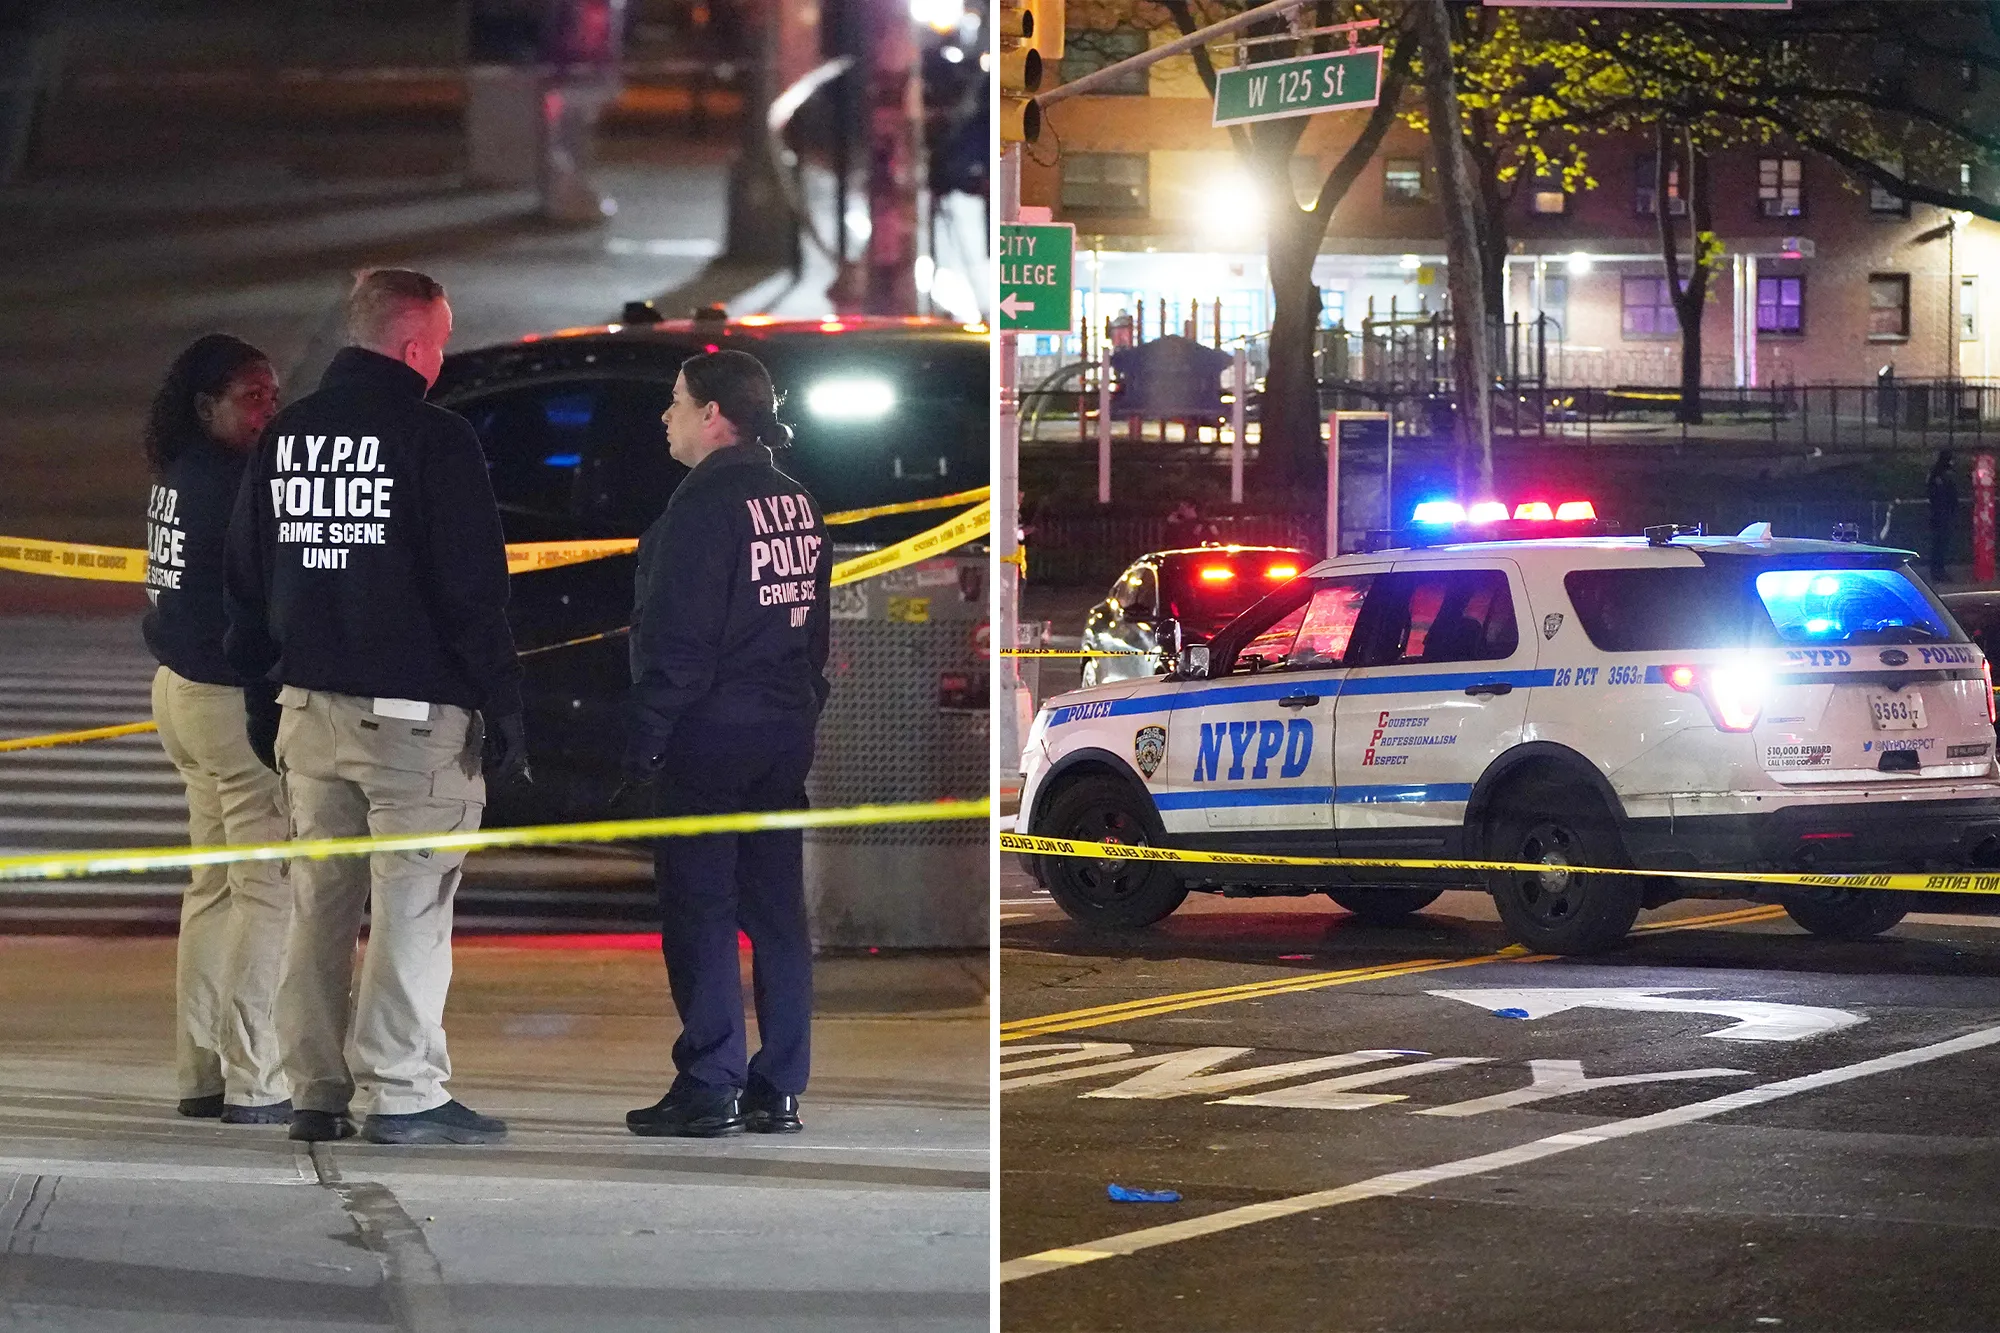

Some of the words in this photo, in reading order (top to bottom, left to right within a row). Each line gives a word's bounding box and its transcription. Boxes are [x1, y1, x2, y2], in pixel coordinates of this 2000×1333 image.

[1248, 76, 1268, 108] W
[1278, 69, 1312, 104] 125
[1322, 64, 1345, 98] St
[1000, 264, 1057, 285] LLEGE
[276, 435, 386, 473] N.Y.P.D.
[147, 484, 180, 526] Y.P.D.
[270, 477, 394, 518] POLICE
[278, 522, 324, 543] RIME
[329, 522, 386, 544] SCENE
[148, 522, 186, 568] LICE
[303, 547, 350, 569] UNIT
[751, 535, 822, 581] POLIC
[760, 582, 800, 606] CRIME
[801, 580, 816, 601] SCE
[1917, 647, 1975, 664] POLICE
[1555, 668, 1572, 687] 26
[1574, 667, 1599, 686] PCT
[1067, 701, 1112, 722] POLICE
[1874, 702, 1908, 720] 3563
[1193, 718, 1314, 782] NYPD
[1767, 746, 1799, 756] $10,000
[1800, 745, 1832, 755] REWARD
[1875, 738, 1936, 751] @NYPD26PCT
[1000, 835, 1034, 849] ENTER
[1036, 839, 1057, 851] NOT
[1057, 841, 1075, 853] DO
[1101, 846, 1139, 857] ENTER
[1141, 849, 1163, 859] NOT
[1000, 1043, 1756, 1117] NLY
